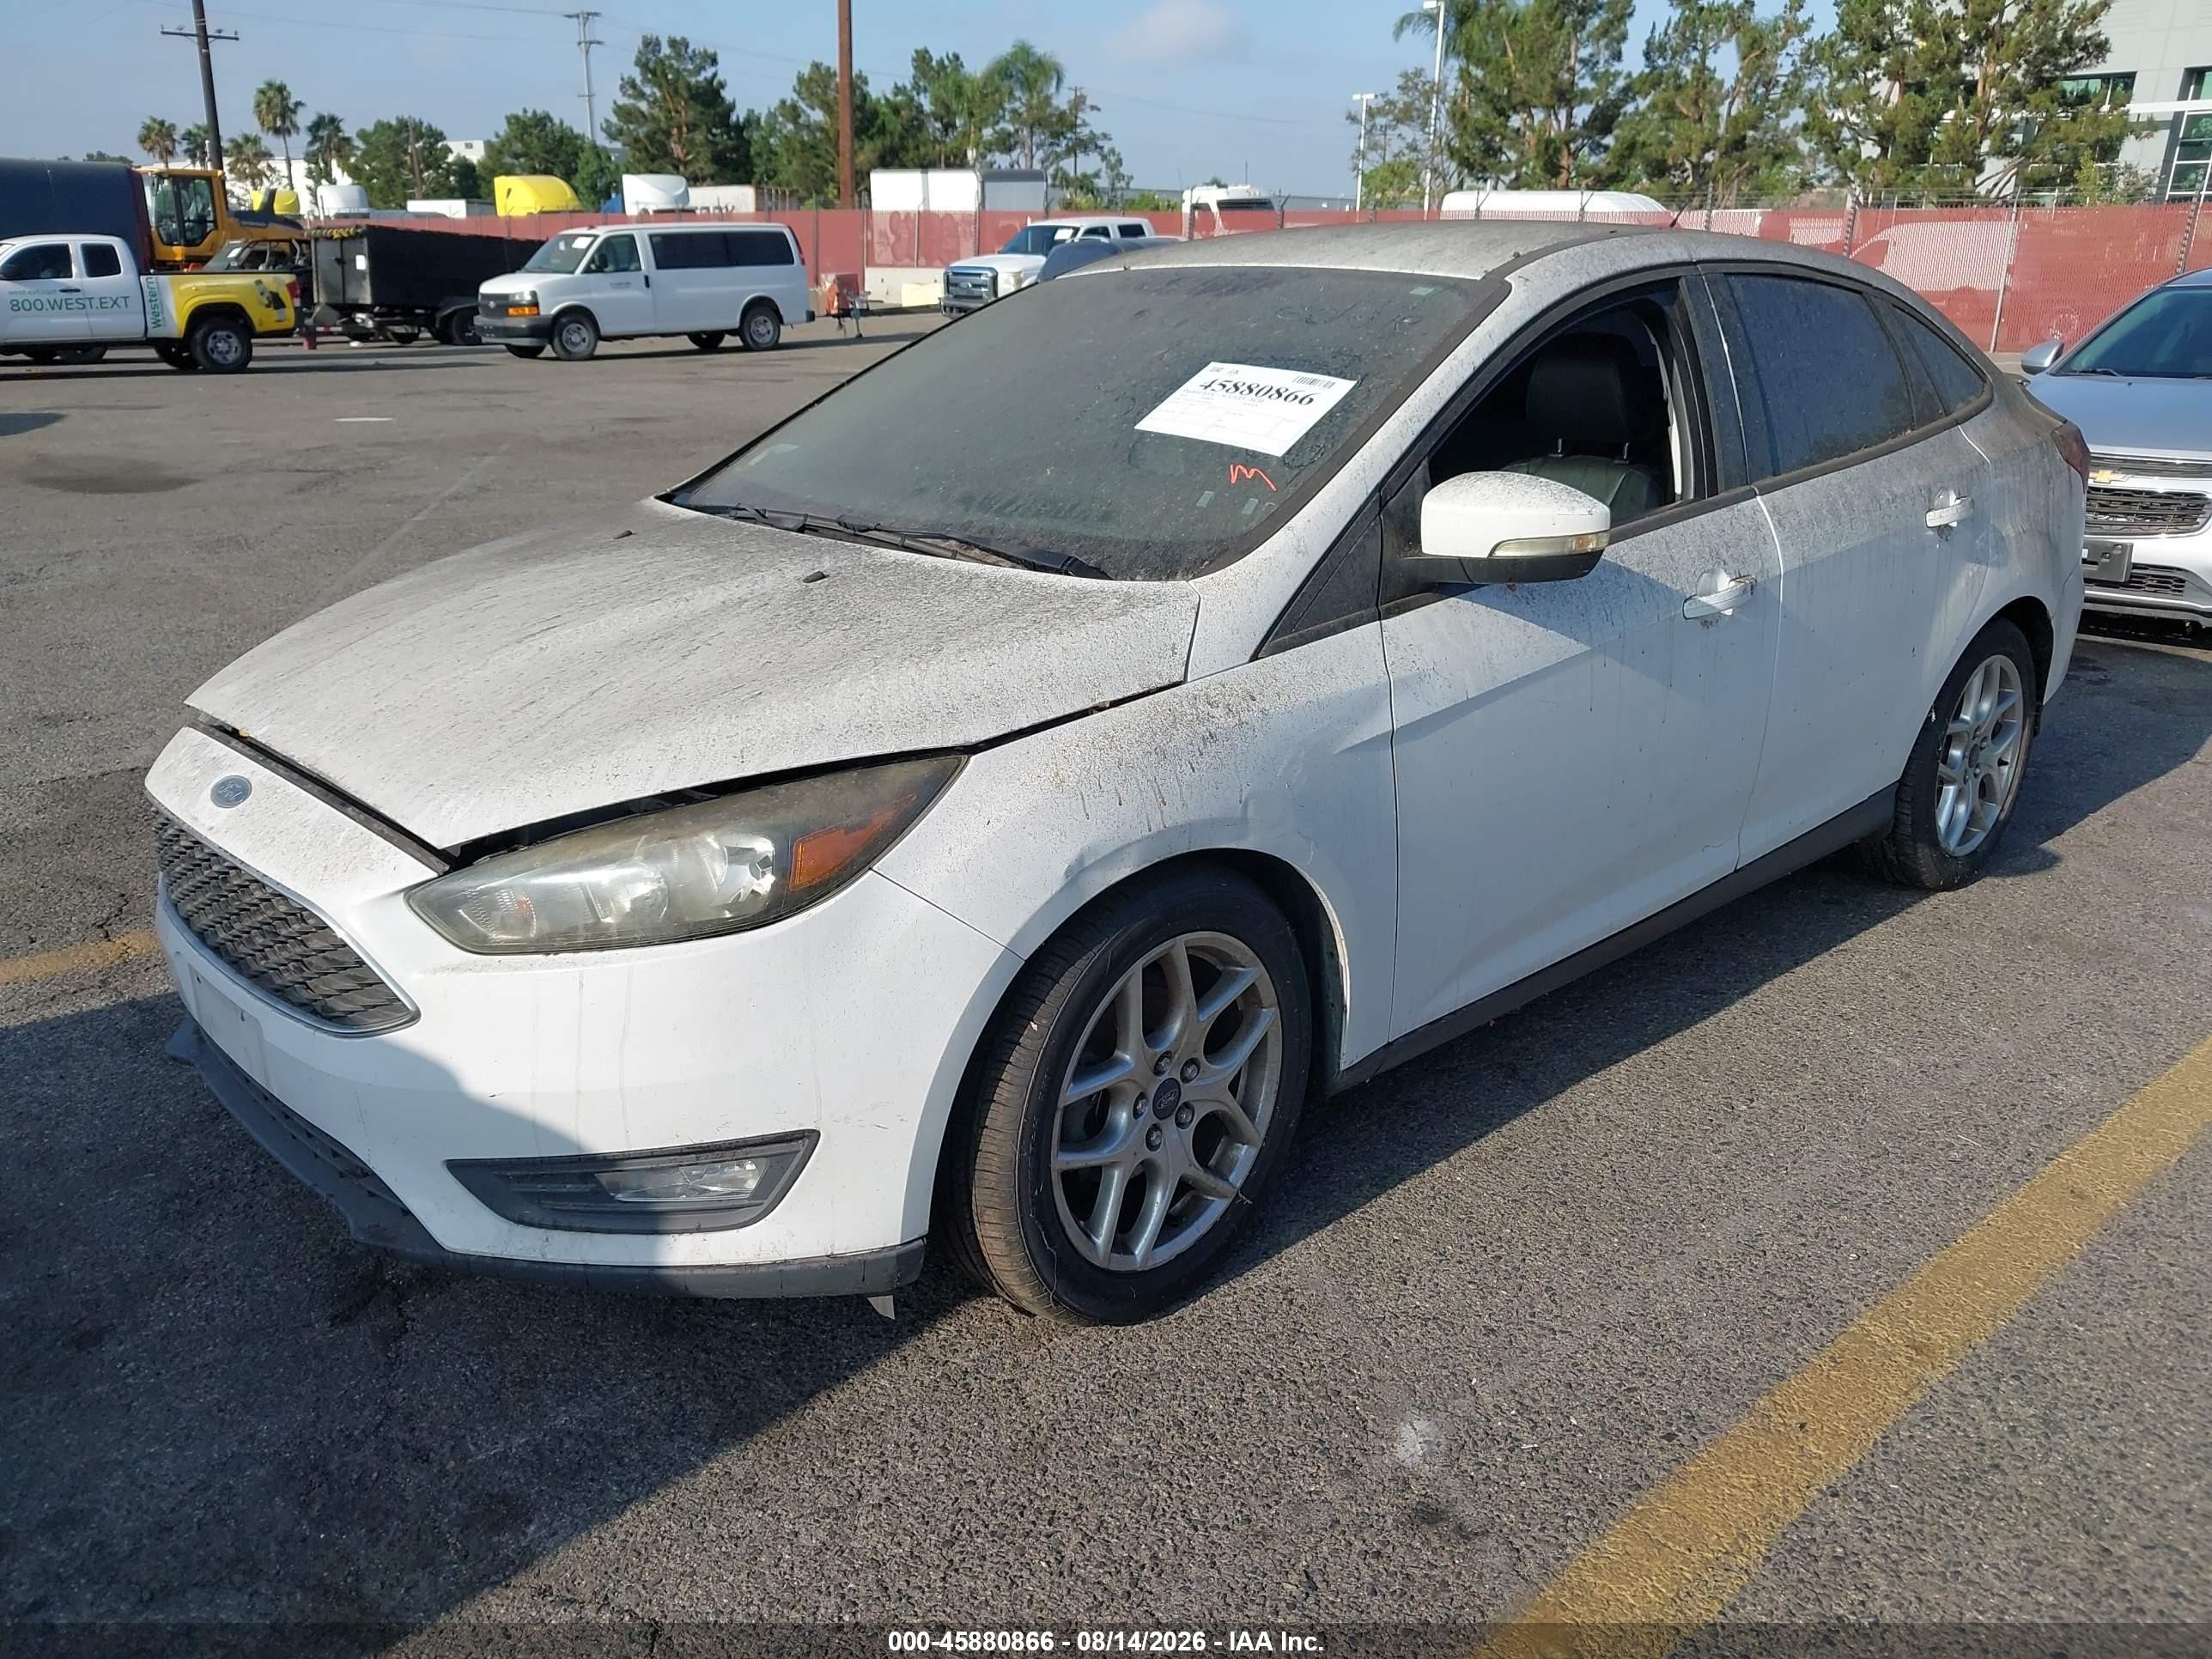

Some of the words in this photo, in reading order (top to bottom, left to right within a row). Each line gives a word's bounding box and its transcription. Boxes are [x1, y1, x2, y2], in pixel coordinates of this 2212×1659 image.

[9, 296, 131, 312] 800.WEST.EXT
[146, 276, 161, 328] Western
[1200, 378, 1321, 406] 45880866
